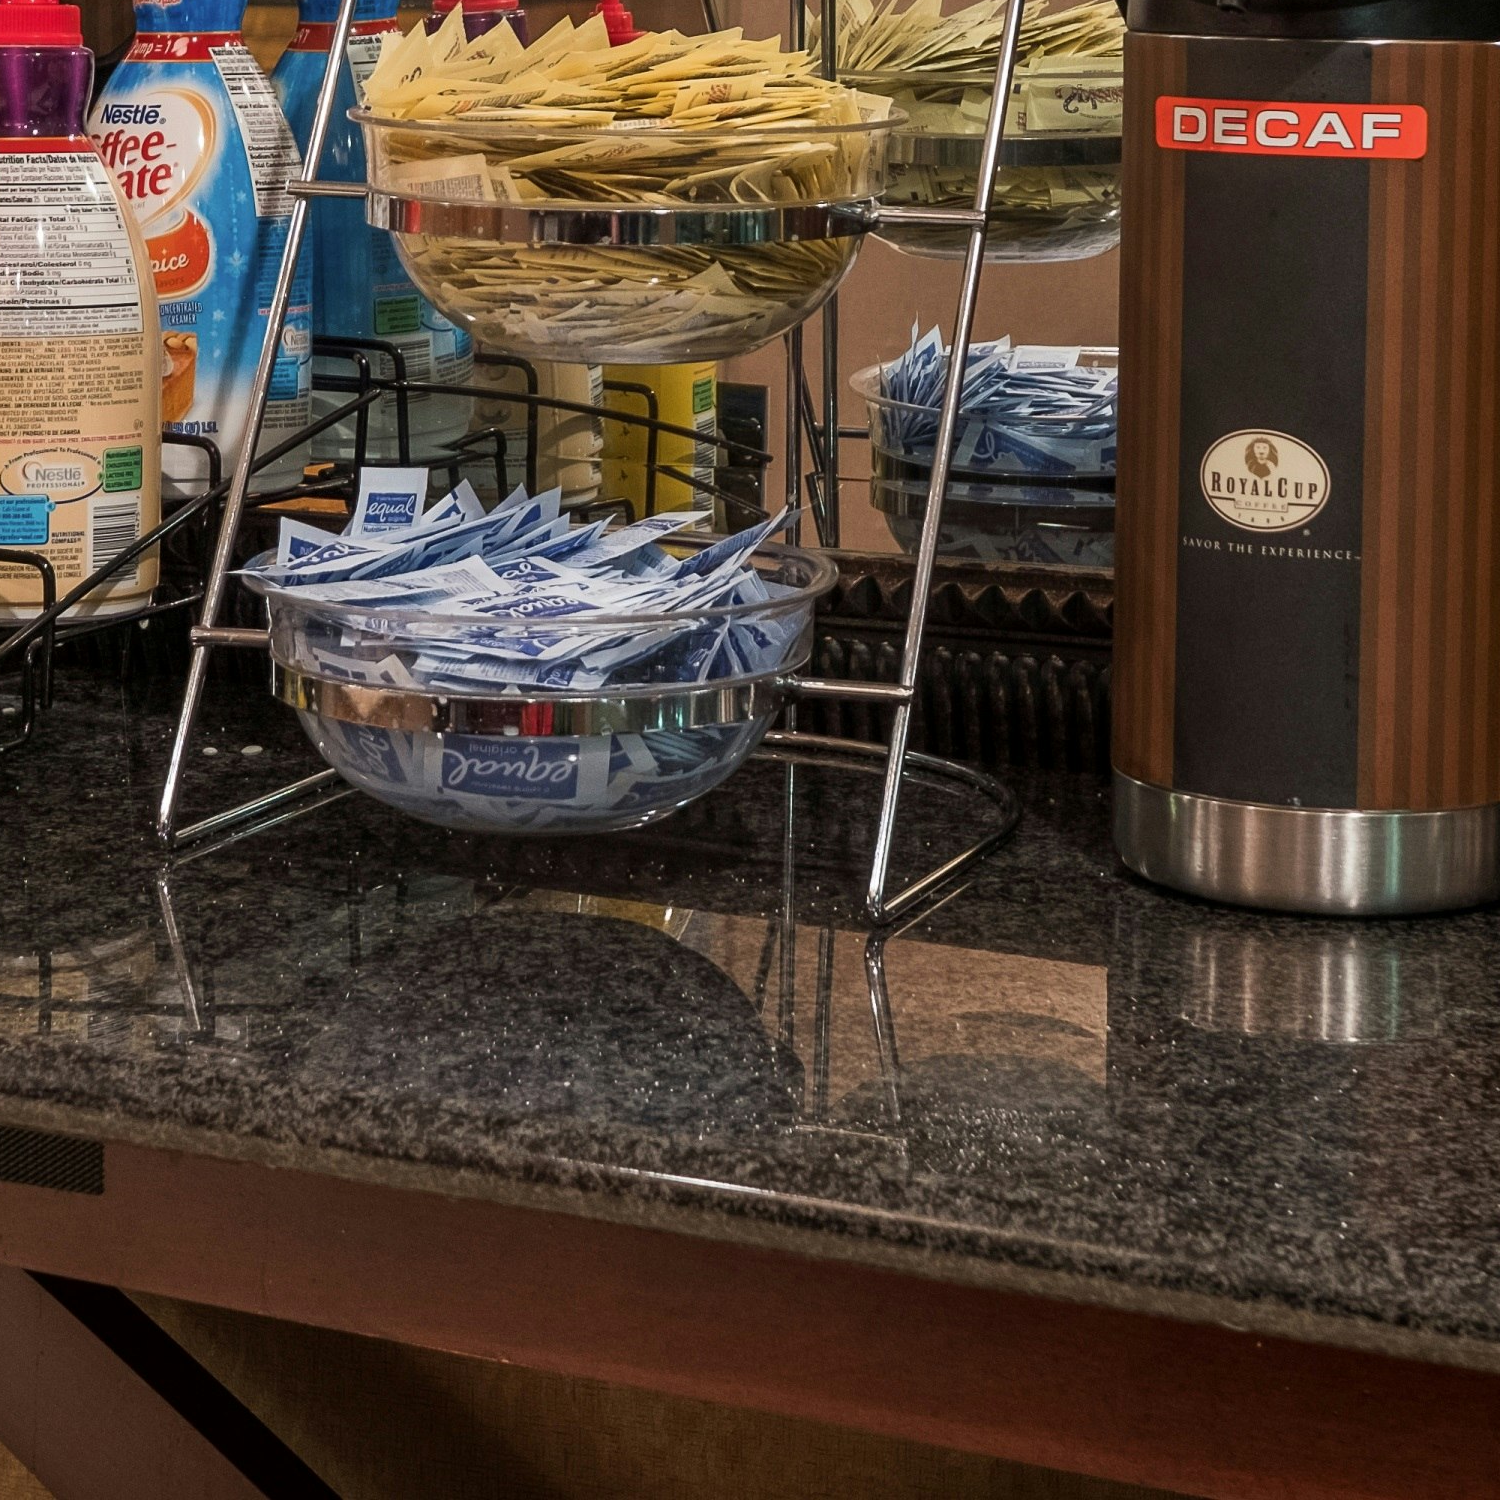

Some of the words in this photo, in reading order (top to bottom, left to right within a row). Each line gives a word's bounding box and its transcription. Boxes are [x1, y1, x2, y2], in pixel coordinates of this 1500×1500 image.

[100, 104, 162, 125] Nestlé
[1173, 106, 1402, 149] DECAF
[92, 129, 177, 168] ffee-
[117, 163, 173, 200] ate
[151, 253, 189, 273] pice
[160, 301, 203, 316] ONCENTRATED
[36, 467, 81, 480] Nestlé
[367, 495, 414, 522] equal
[1183, 535, 1221, 550] SAVOR
[1228, 542, 1253, 554] THE
[443, 746, 578, 786] equal
